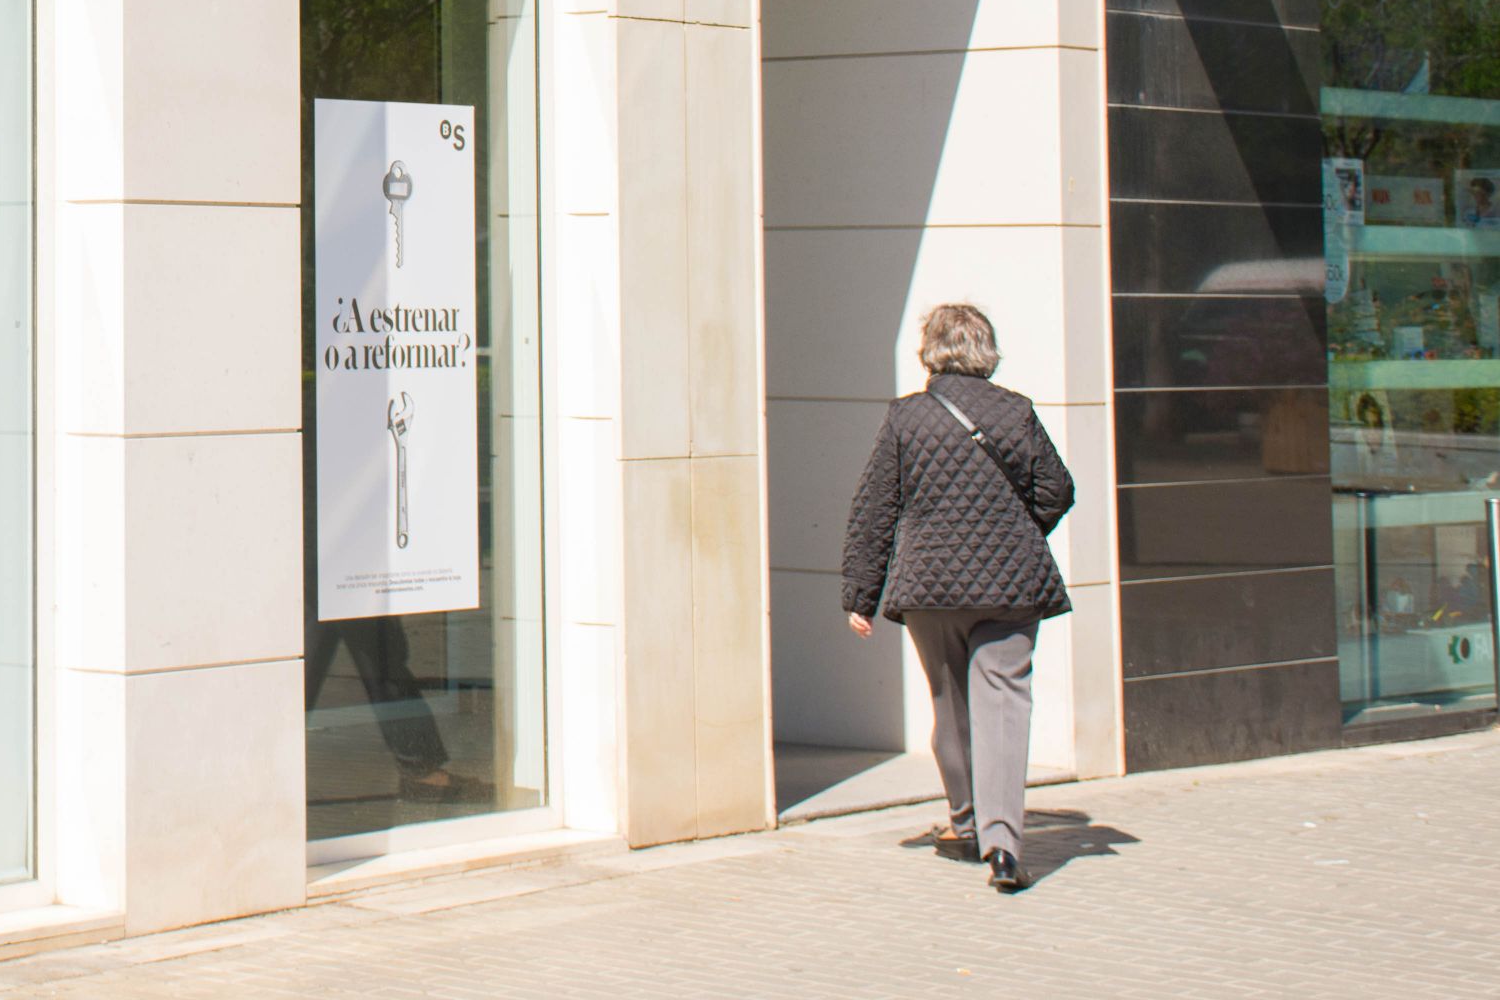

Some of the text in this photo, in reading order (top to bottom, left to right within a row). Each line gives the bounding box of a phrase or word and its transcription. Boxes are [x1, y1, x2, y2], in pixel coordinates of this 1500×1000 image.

[453, 124, 465, 151] S
[332, 297, 460, 333] ¿A estrenar
[324, 333, 471, 371] o a reformar?
